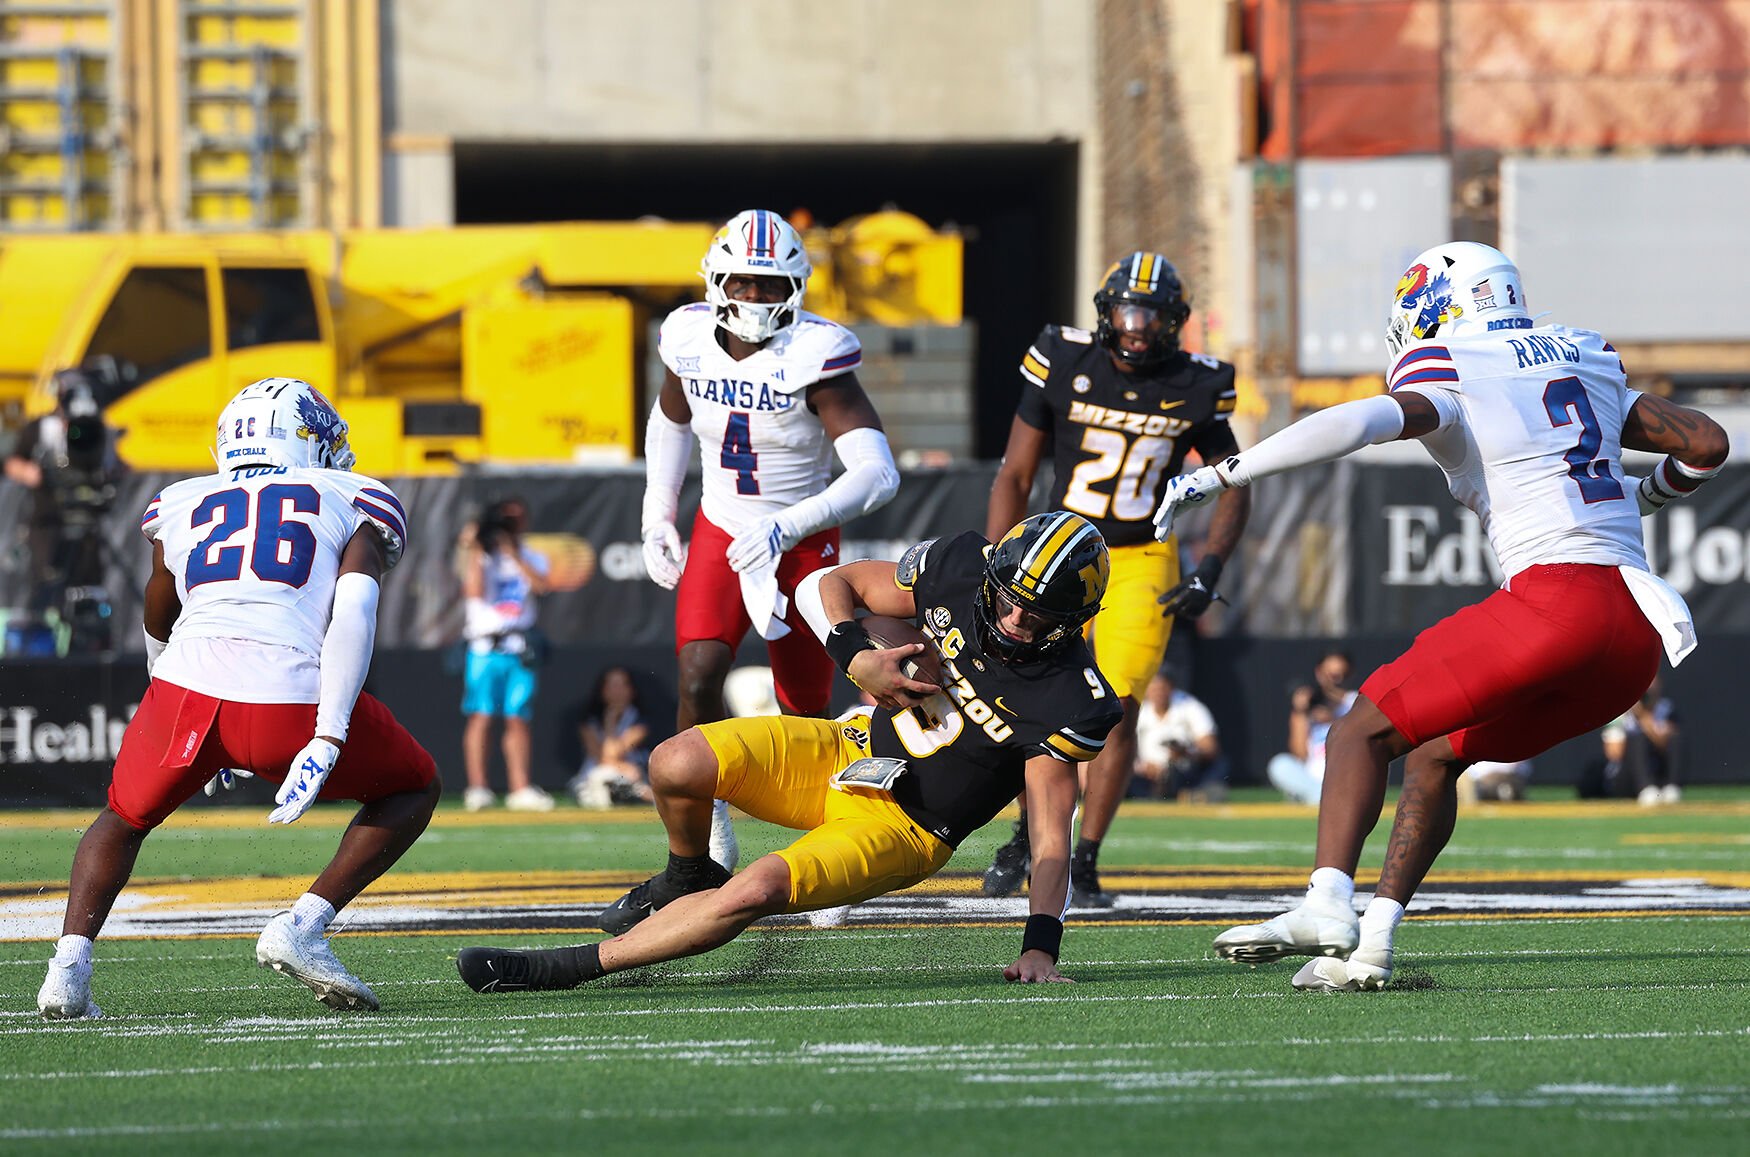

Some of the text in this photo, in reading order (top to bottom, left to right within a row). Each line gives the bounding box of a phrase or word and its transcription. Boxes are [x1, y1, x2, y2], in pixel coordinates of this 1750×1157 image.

[1506, 284, 1516, 305] 2
[1505, 335, 1581, 368] RAWLS
[234, 416, 257, 440] 26
[315, 410, 333, 428] KU
[1067, 400, 1193, 438] MIZZOU
[720, 410, 762, 496] 4
[1542, 375, 1625, 505] 2
[1062, 427, 1176, 522] 20
[186, 483, 323, 591] 26
[1010, 582, 1037, 602] MIZZOU
[941, 626, 966, 660] C
[1083, 667, 1106, 700] 9
